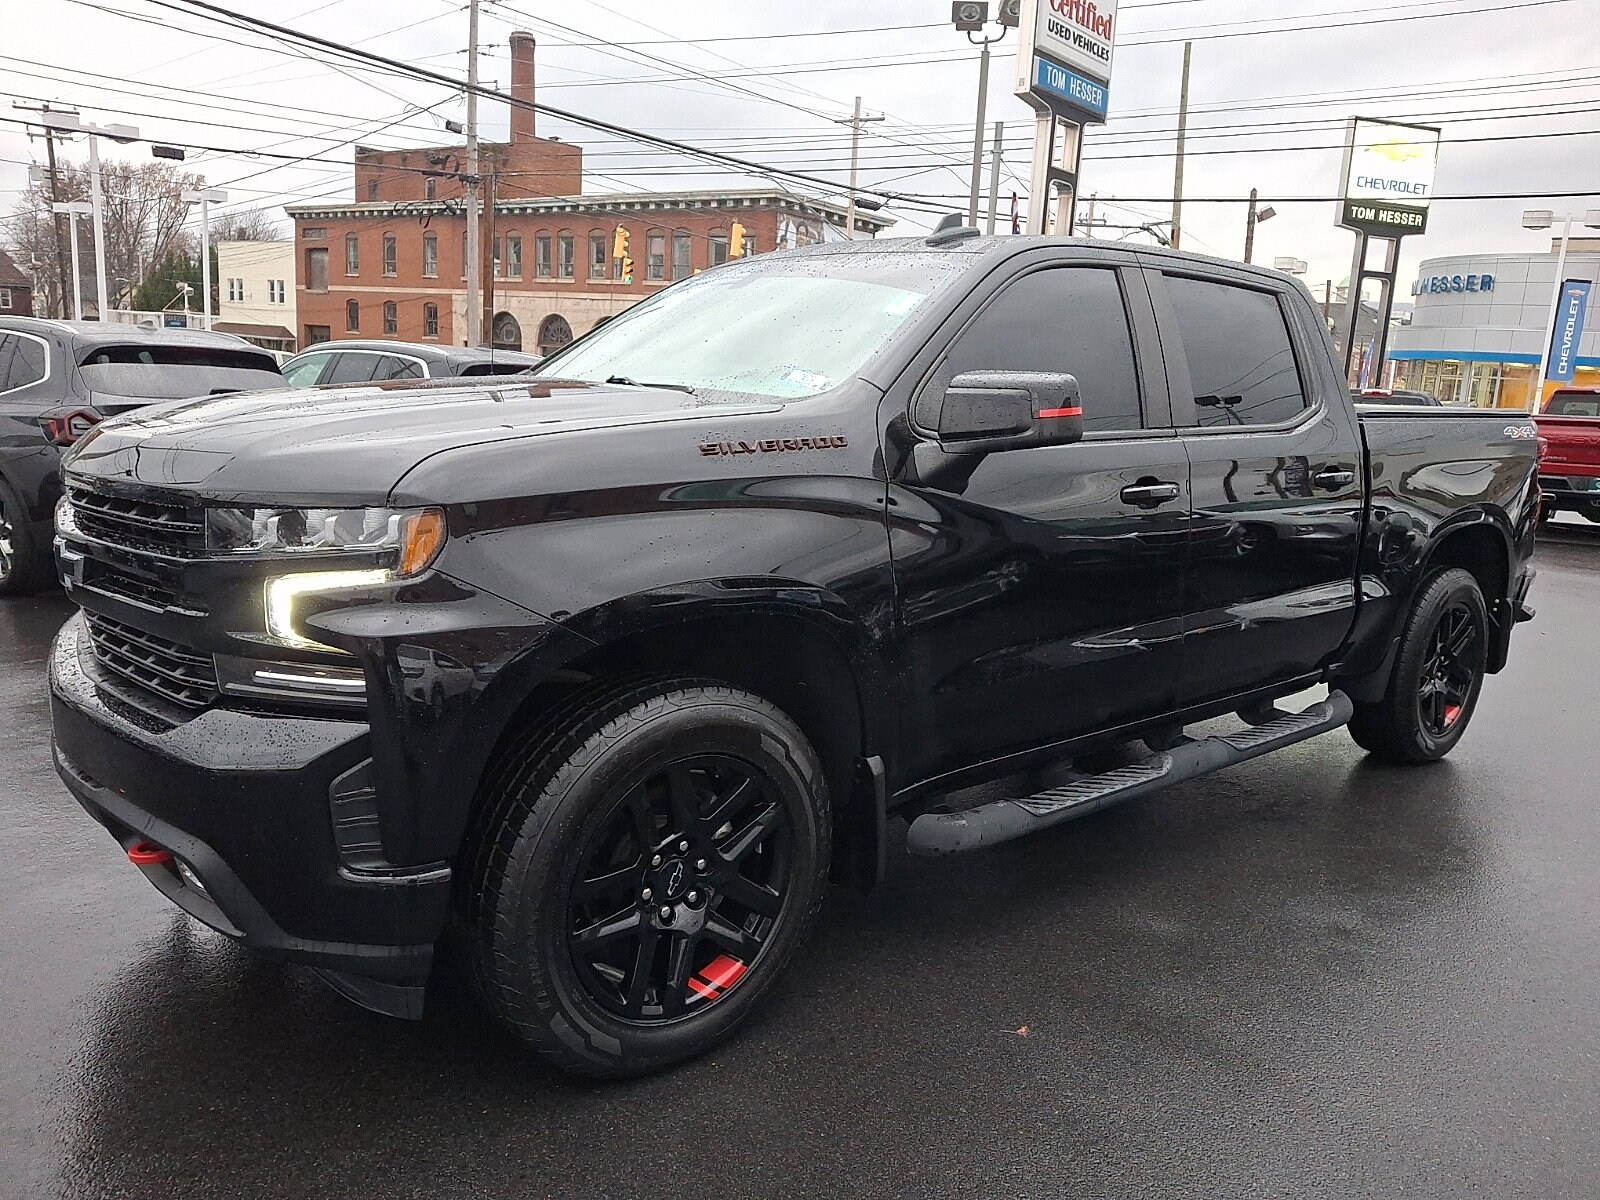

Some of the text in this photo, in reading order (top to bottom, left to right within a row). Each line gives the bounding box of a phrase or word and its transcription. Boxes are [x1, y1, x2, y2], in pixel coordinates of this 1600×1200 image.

[1048, 18, 1110, 61] USED VEHICLES
[1046, 65, 1103, 107] TOM HESSER
[1356, 175, 1428, 195] CHEVROLET
[1351, 205, 1423, 227] TOM HESSER
[1558, 297, 1580, 375] CHEVROLET
[699, 434, 849, 457] SILVERADO
